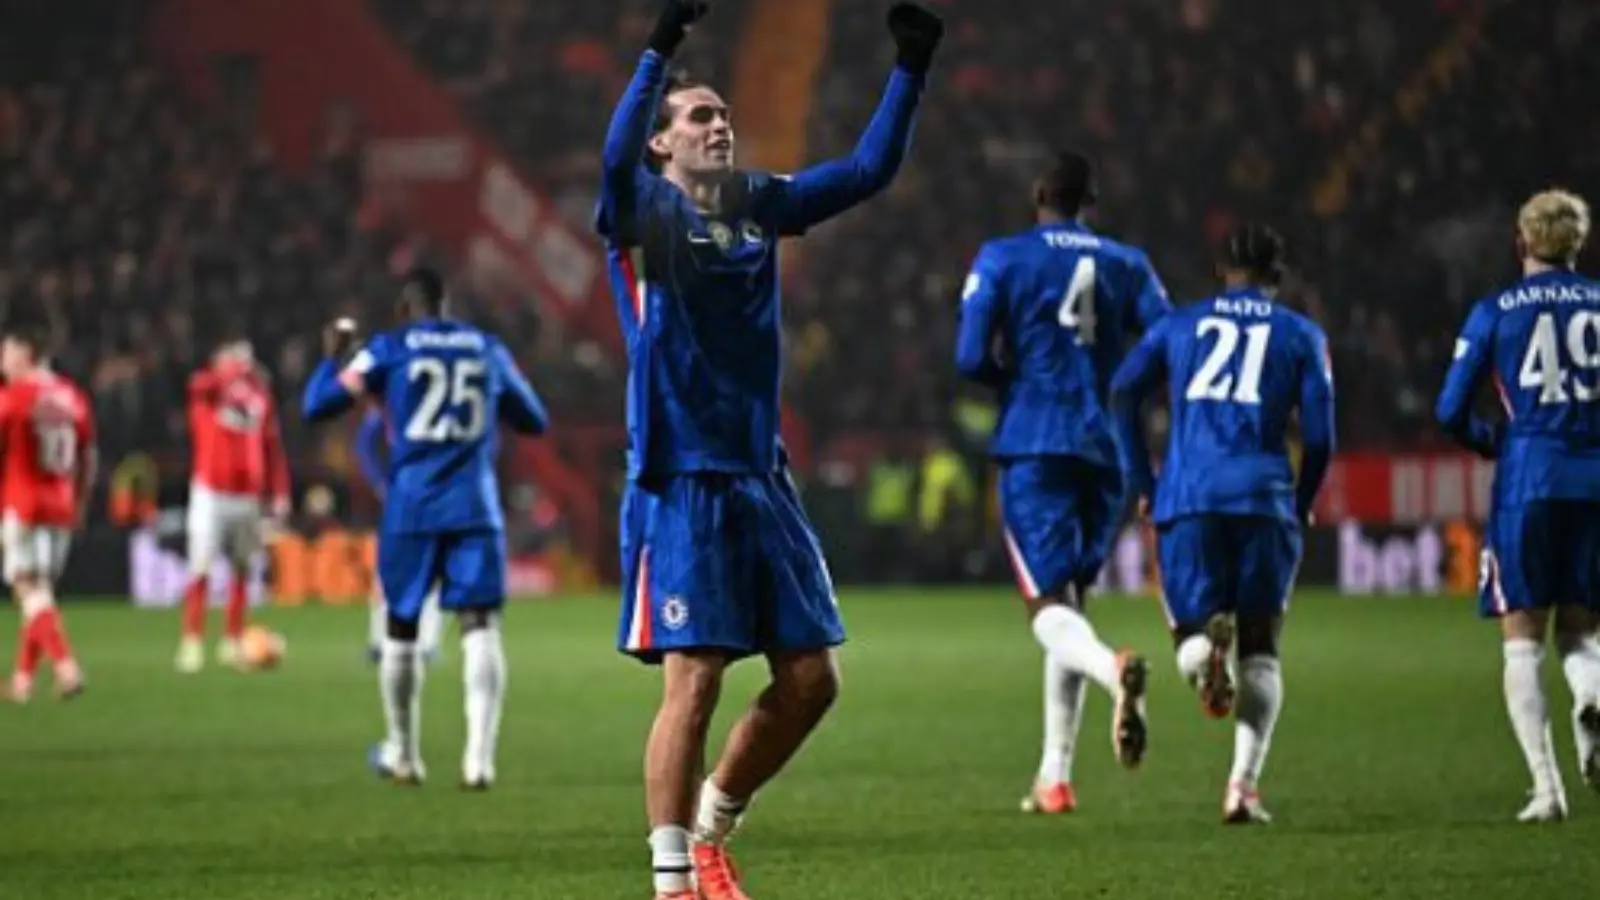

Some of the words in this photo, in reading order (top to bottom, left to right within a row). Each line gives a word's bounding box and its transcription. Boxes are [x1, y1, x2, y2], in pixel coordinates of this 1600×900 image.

[1058, 255, 1098, 346] 4
[404, 357, 486, 441] 25
[1186, 316, 1271, 404] 21
[1518, 309, 1600, 404] 49
